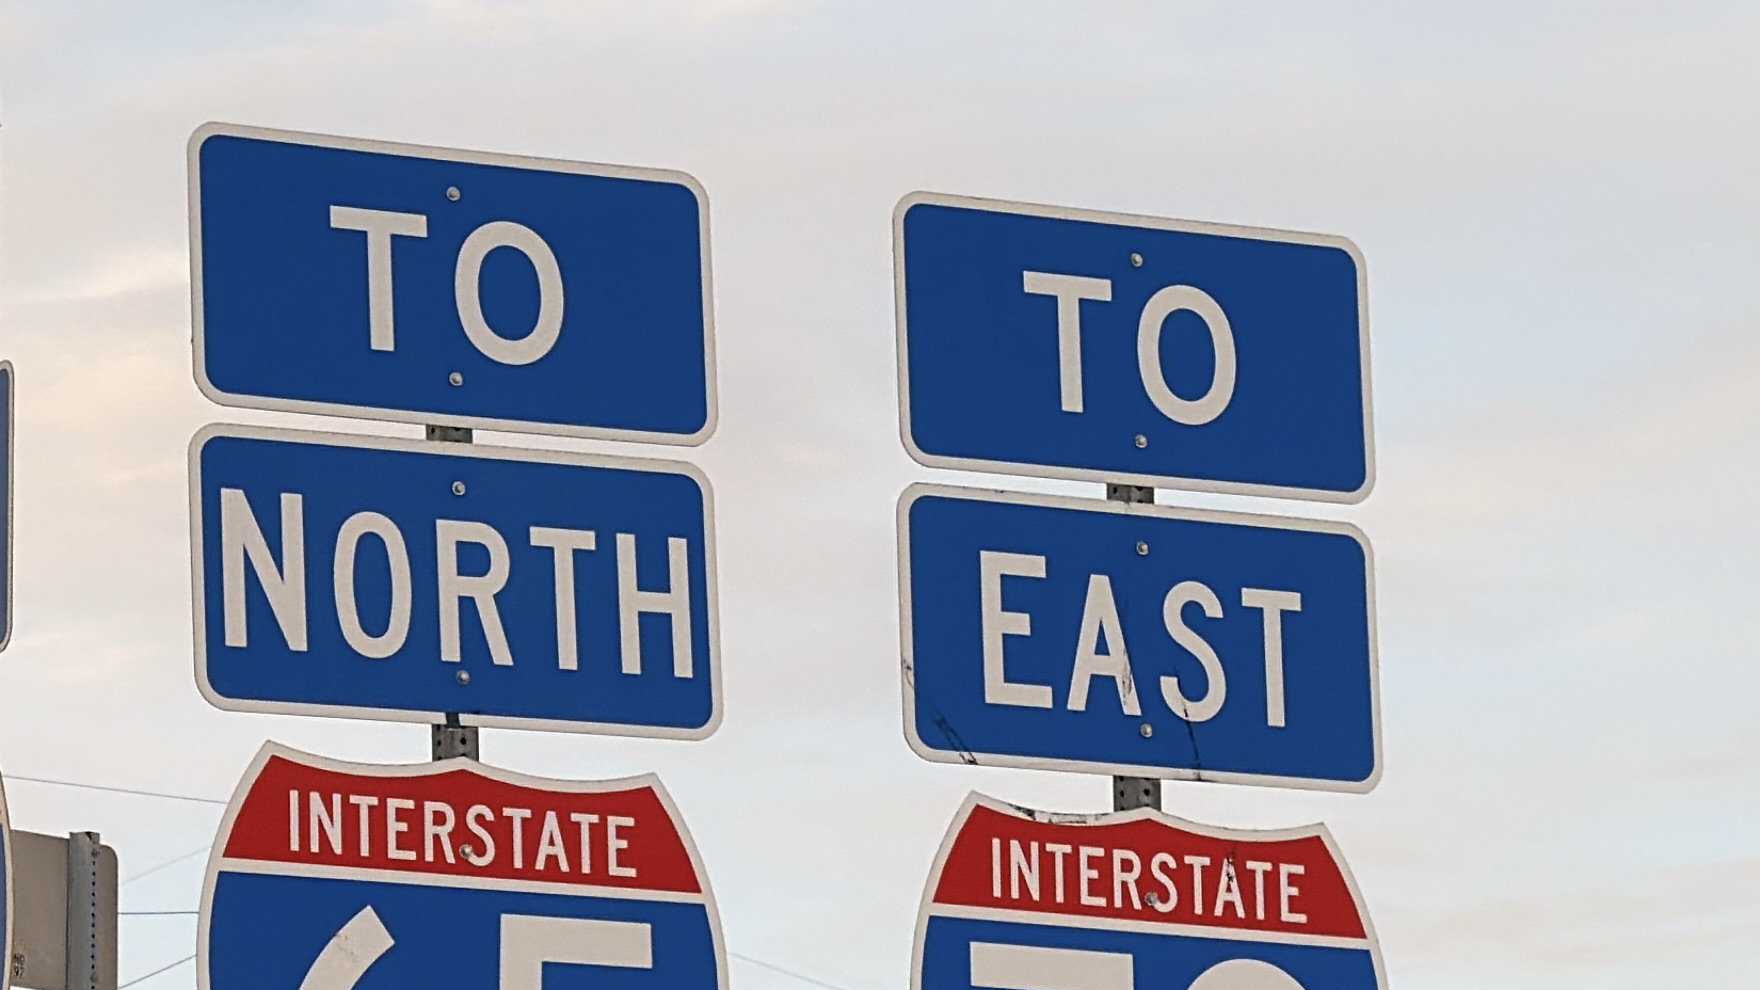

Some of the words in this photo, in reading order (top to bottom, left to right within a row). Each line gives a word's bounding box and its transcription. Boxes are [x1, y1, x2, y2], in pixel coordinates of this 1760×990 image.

[329, 204, 565, 366] TO
[1023, 270, 1237, 426] TO
[220, 486, 694, 679] NORTH
[979, 550, 1302, 728] EAST
[288, 789, 638, 878] INTERSTATE
[991, 837, 1308, 924] INTERSTATE
